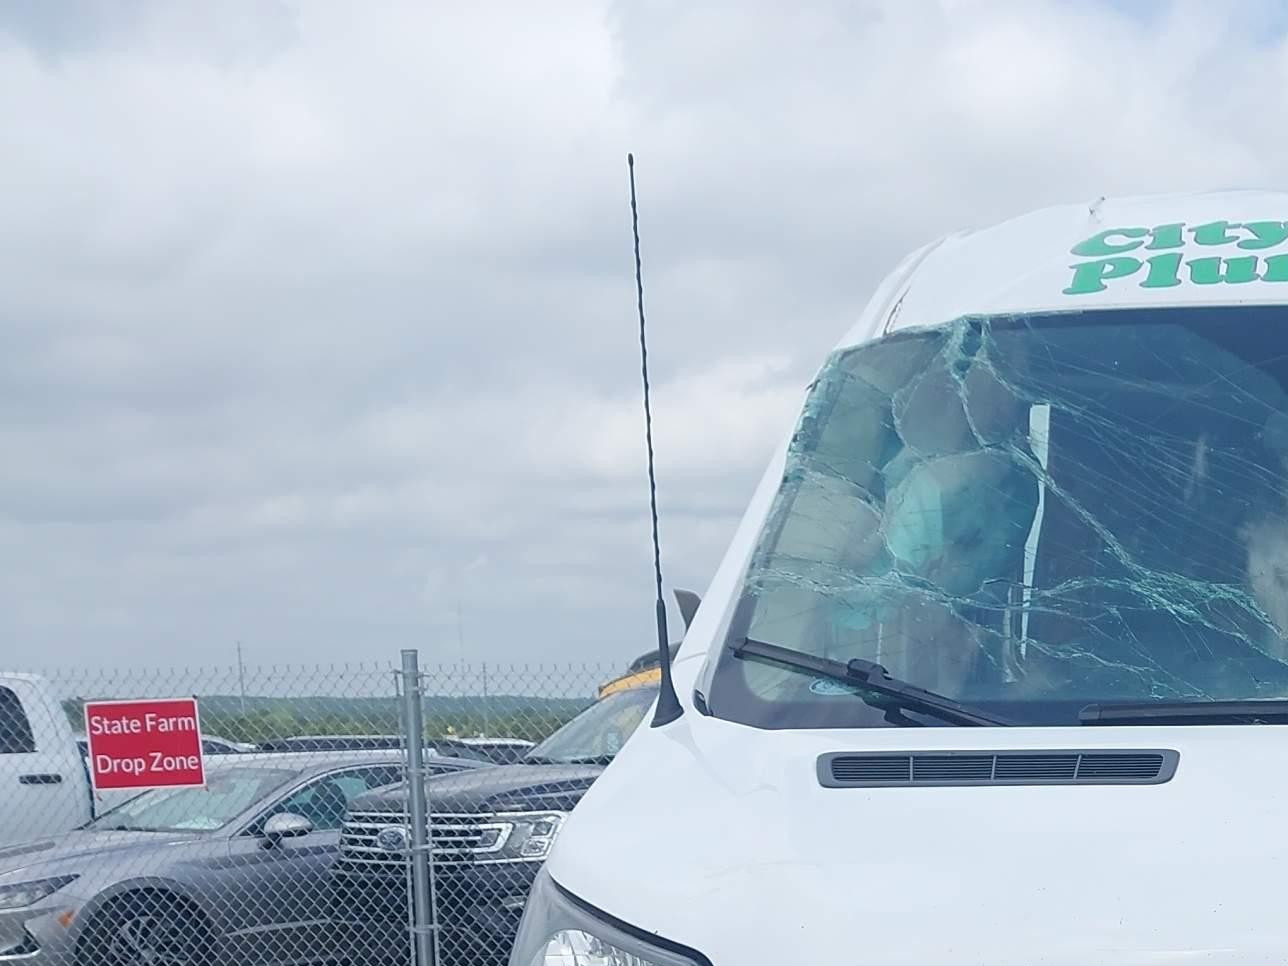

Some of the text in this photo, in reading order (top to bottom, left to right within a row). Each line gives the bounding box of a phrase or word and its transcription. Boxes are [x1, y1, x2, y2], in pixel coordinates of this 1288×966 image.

[90, 713, 195, 735] State Farm
[96, 752, 199, 776] Drop Zone
